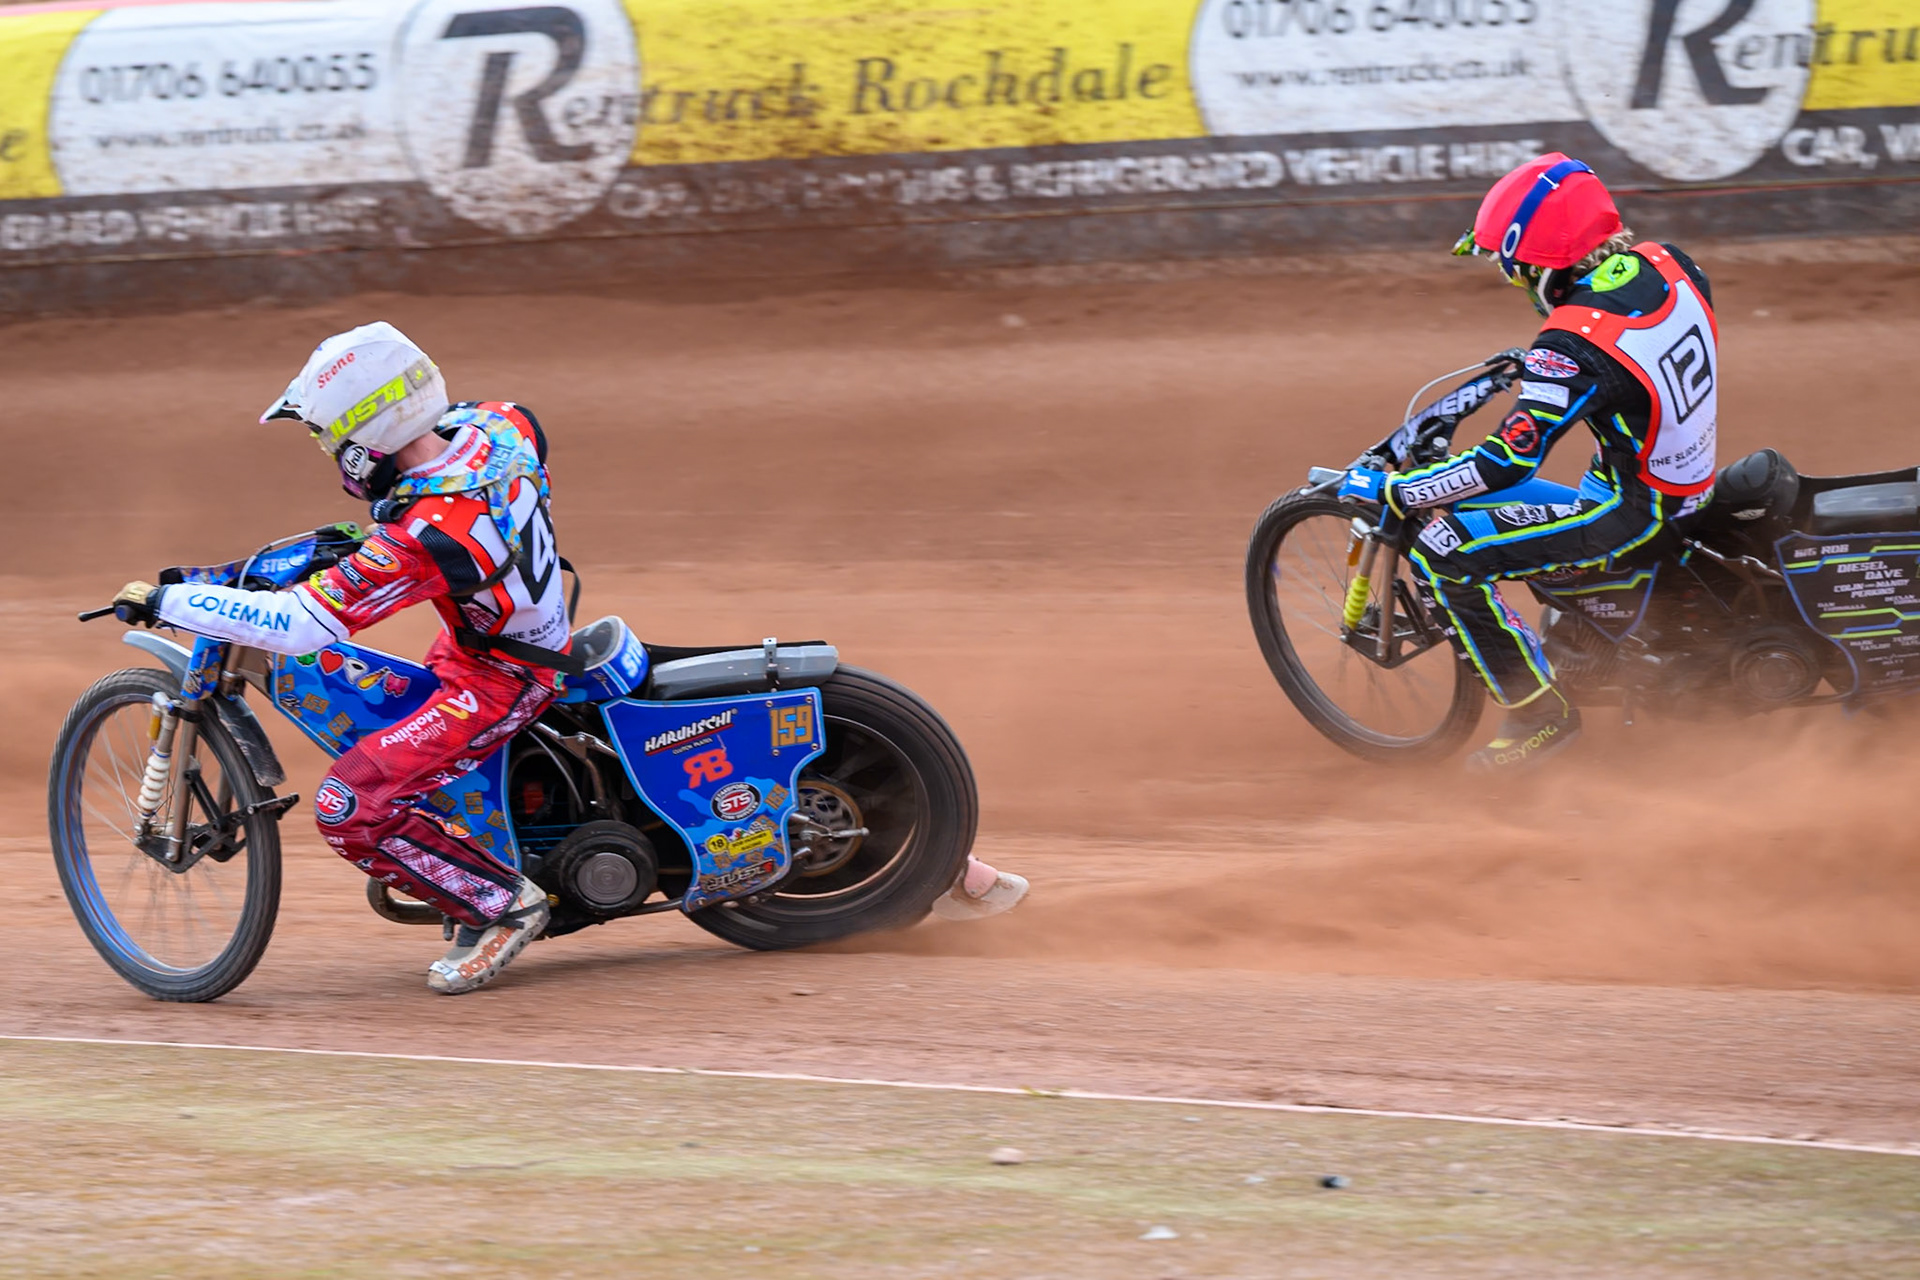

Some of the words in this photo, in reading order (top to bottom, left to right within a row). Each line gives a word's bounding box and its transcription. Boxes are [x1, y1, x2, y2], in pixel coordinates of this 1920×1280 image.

[80, 63, 207, 104] 01706
[217, 53, 377, 97] 640055
[850, 42, 1172, 115] Rochdale
[1661, 334, 1712, 419] 12
[1650, 455, 1672, 468] THE
[1821, 544, 1849, 555] ROB
[1837, 561, 1888, 573] DIESEL
[1865, 569, 1904, 580] DAVE
[188, 592, 291, 631] COLEMAN
[380, 707, 441, 748] Mobility
[409, 718, 448, 748] Allied
[769, 704, 813, 748] 159
[316, 788, 346, 811] STS
[720, 792, 751, 812] STS
[711, 838, 725, 850] 18
